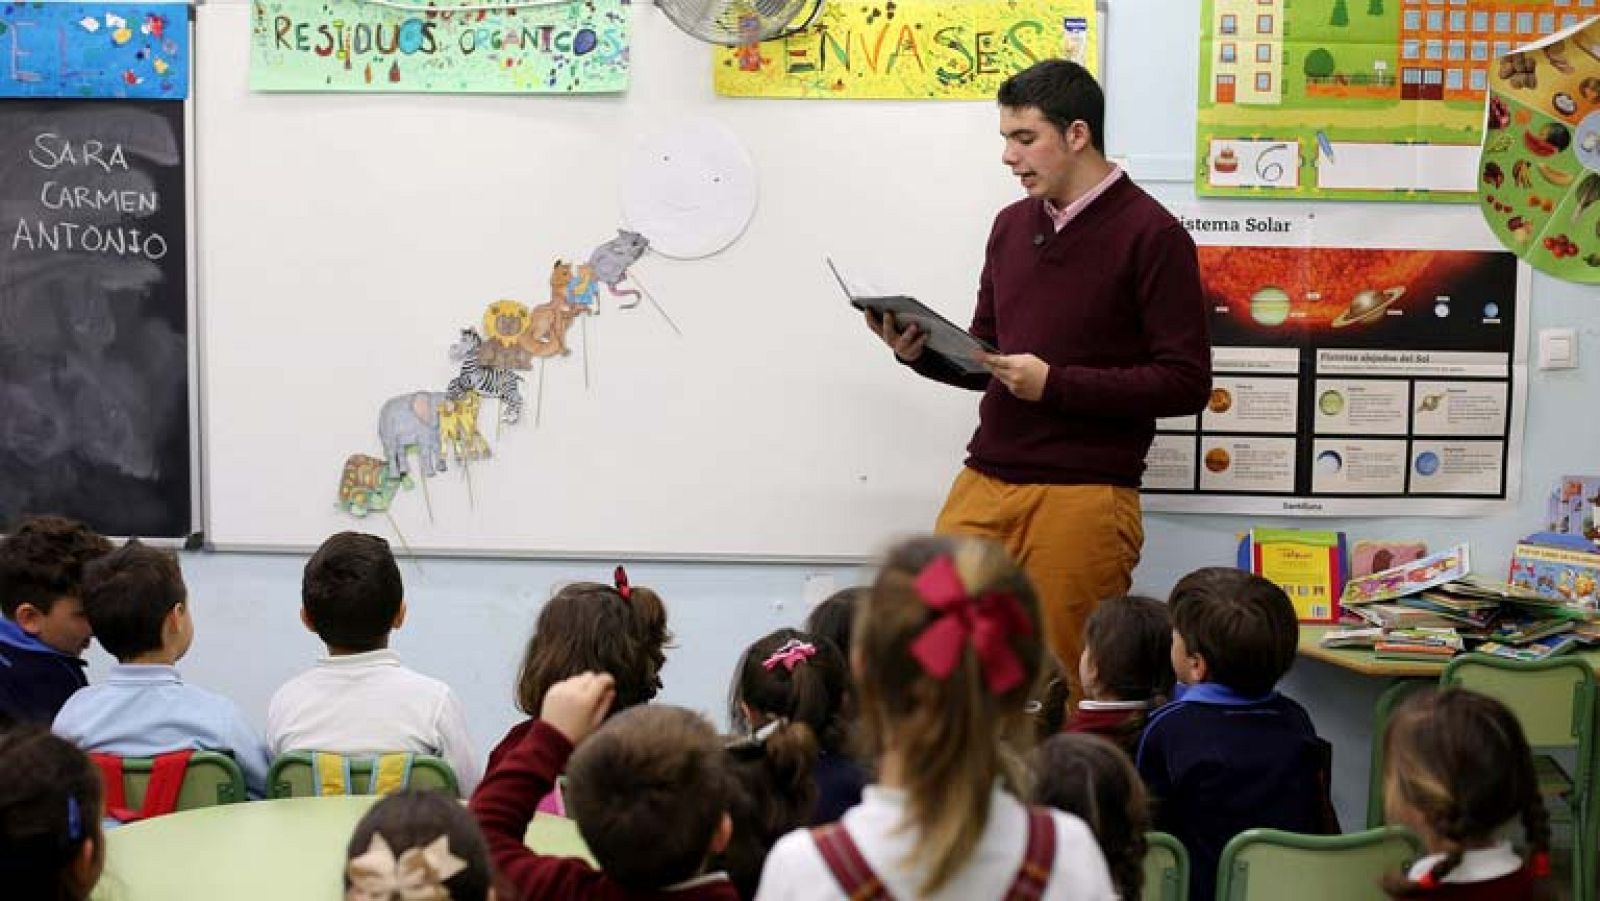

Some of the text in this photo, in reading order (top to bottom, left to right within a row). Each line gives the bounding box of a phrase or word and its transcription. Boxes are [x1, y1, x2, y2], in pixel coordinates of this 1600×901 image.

[274, 15, 620, 61] RESIDUOS ORGANICOS
[784, 20, 1044, 84] ENVASES
[29, 132, 128, 173] SARA
[1255, 143, 1288, 182] 6
[41, 181, 158, 212] CARMEN
[12, 217, 168, 259] ANTONIO
[1245, 216, 1292, 232] Solar
[1416, 354, 1430, 364] Sol
